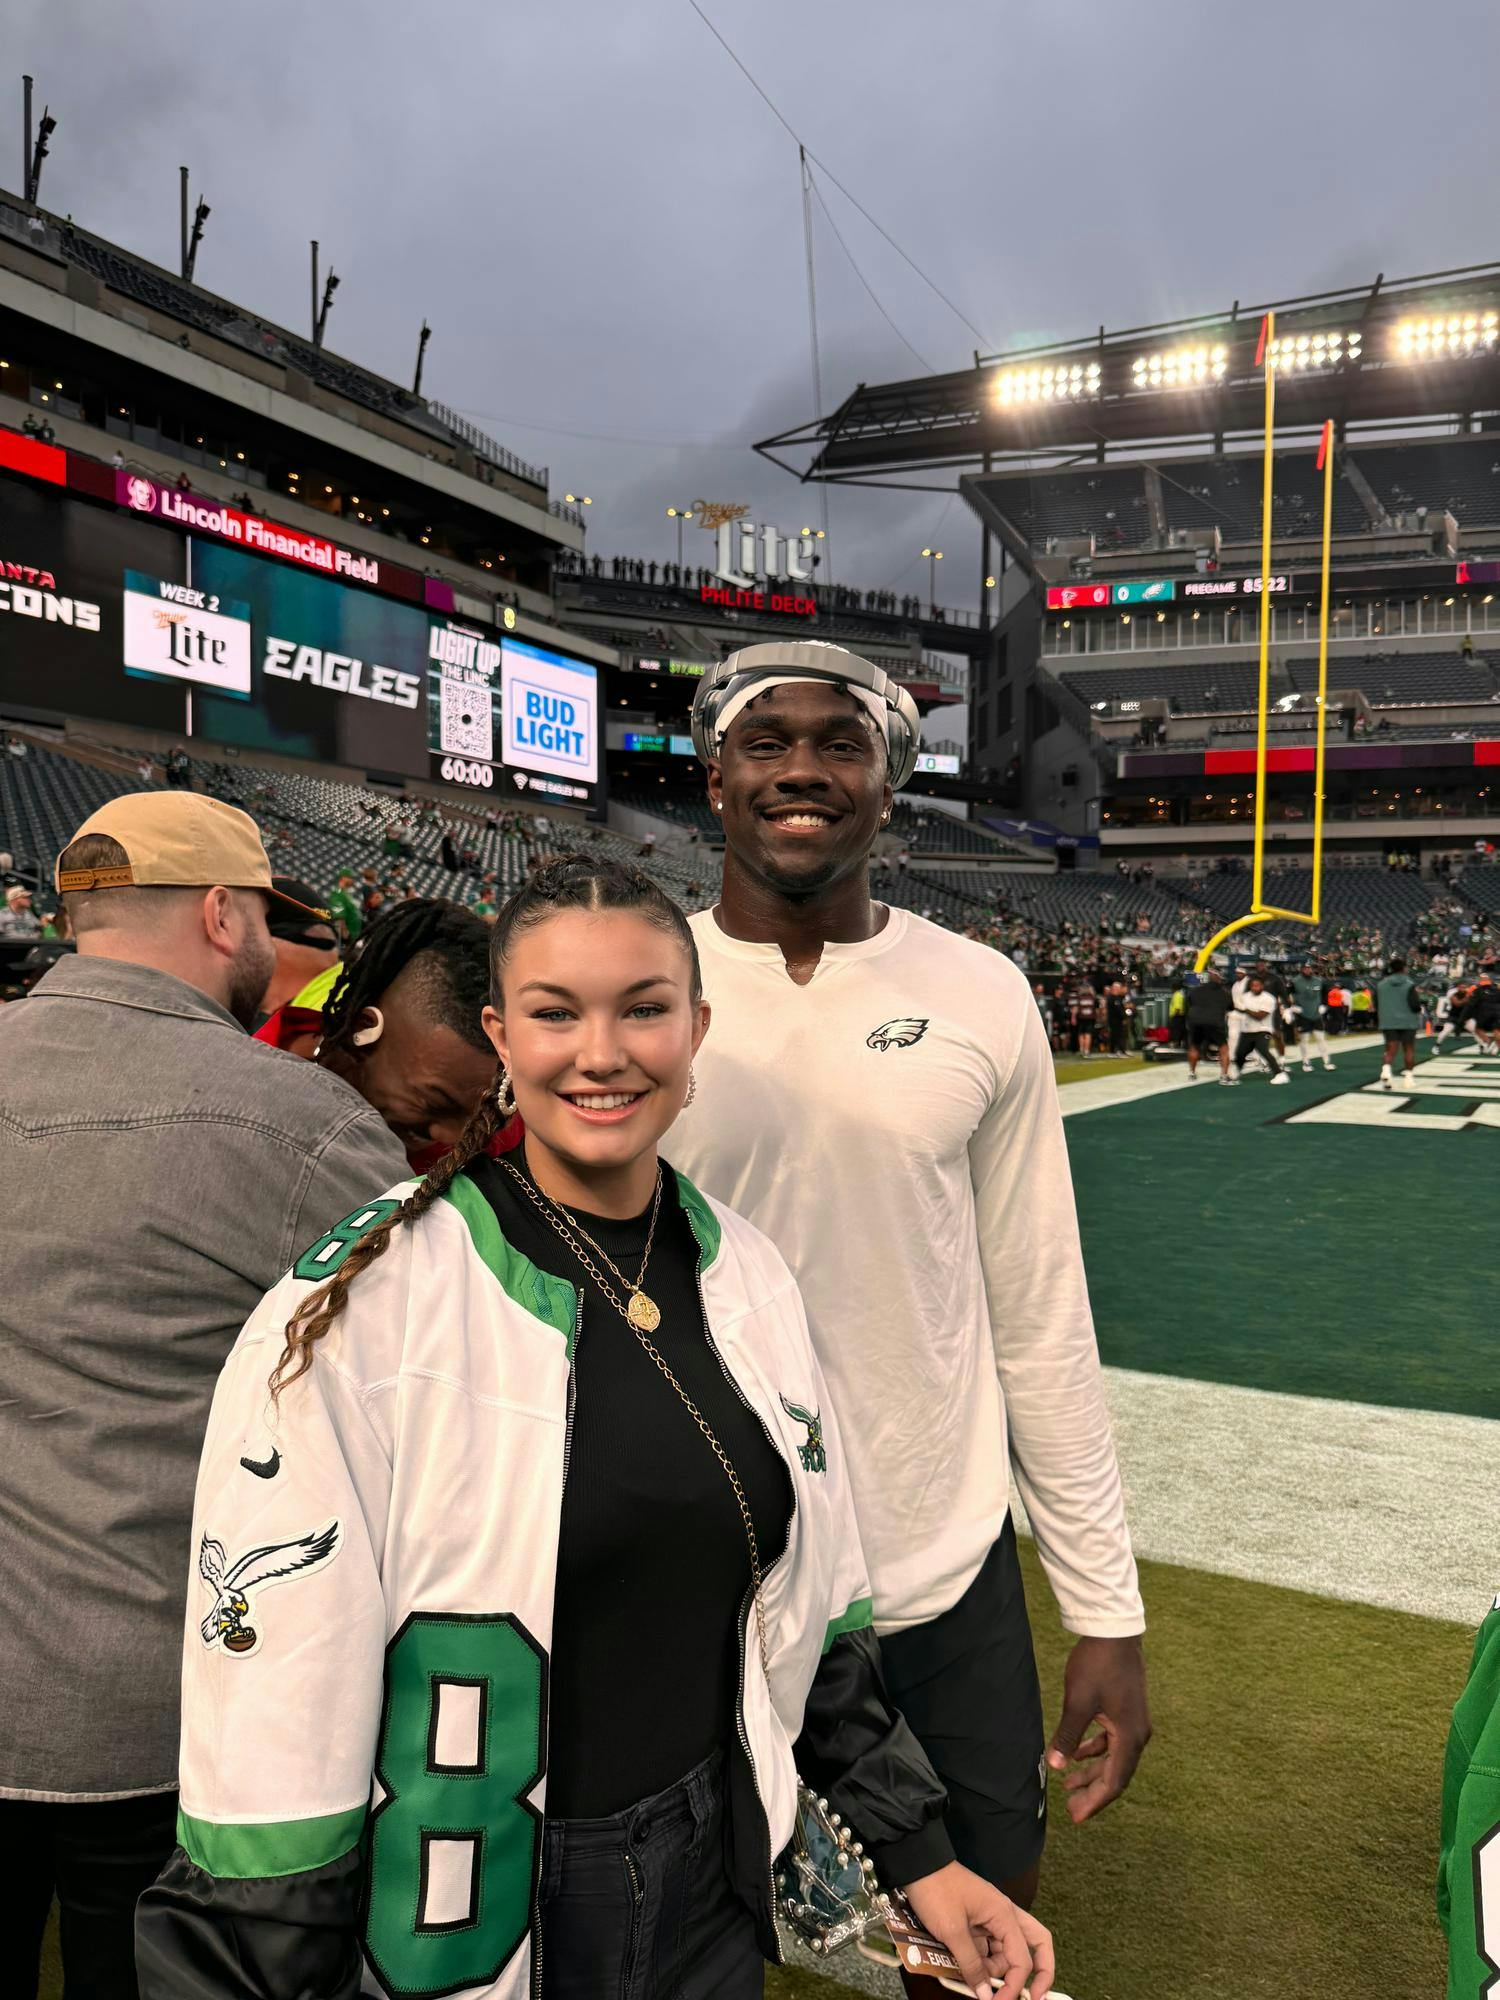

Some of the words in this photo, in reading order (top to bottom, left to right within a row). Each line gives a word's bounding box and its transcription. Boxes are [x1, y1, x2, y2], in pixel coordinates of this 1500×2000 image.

[161, 491, 242, 539] Lincoln
[245, 519, 333, 570] Financial
[335, 550, 378, 584] Field
[707, 519, 815, 589] Lite
[160, 581, 205, 608] WEEK
[209, 595, 220, 612] 2
[700, 585, 765, 609] PHLITE
[771, 594, 816, 616] DECK
[1185, 581, 1237, 595] PREGAME
[168, 621, 227, 667] Lite
[430, 625, 478, 669] LIGHT
[476, 640, 502, 675] UP
[263, 635, 421, 710] EAGLES
[439, 660, 463, 681] THE
[526, 690, 575, 727] BUD
[516, 717, 585, 757] LIGHT
[441, 757, 494, 788] 60:00
[359, 1611, 549, 2000] 8
